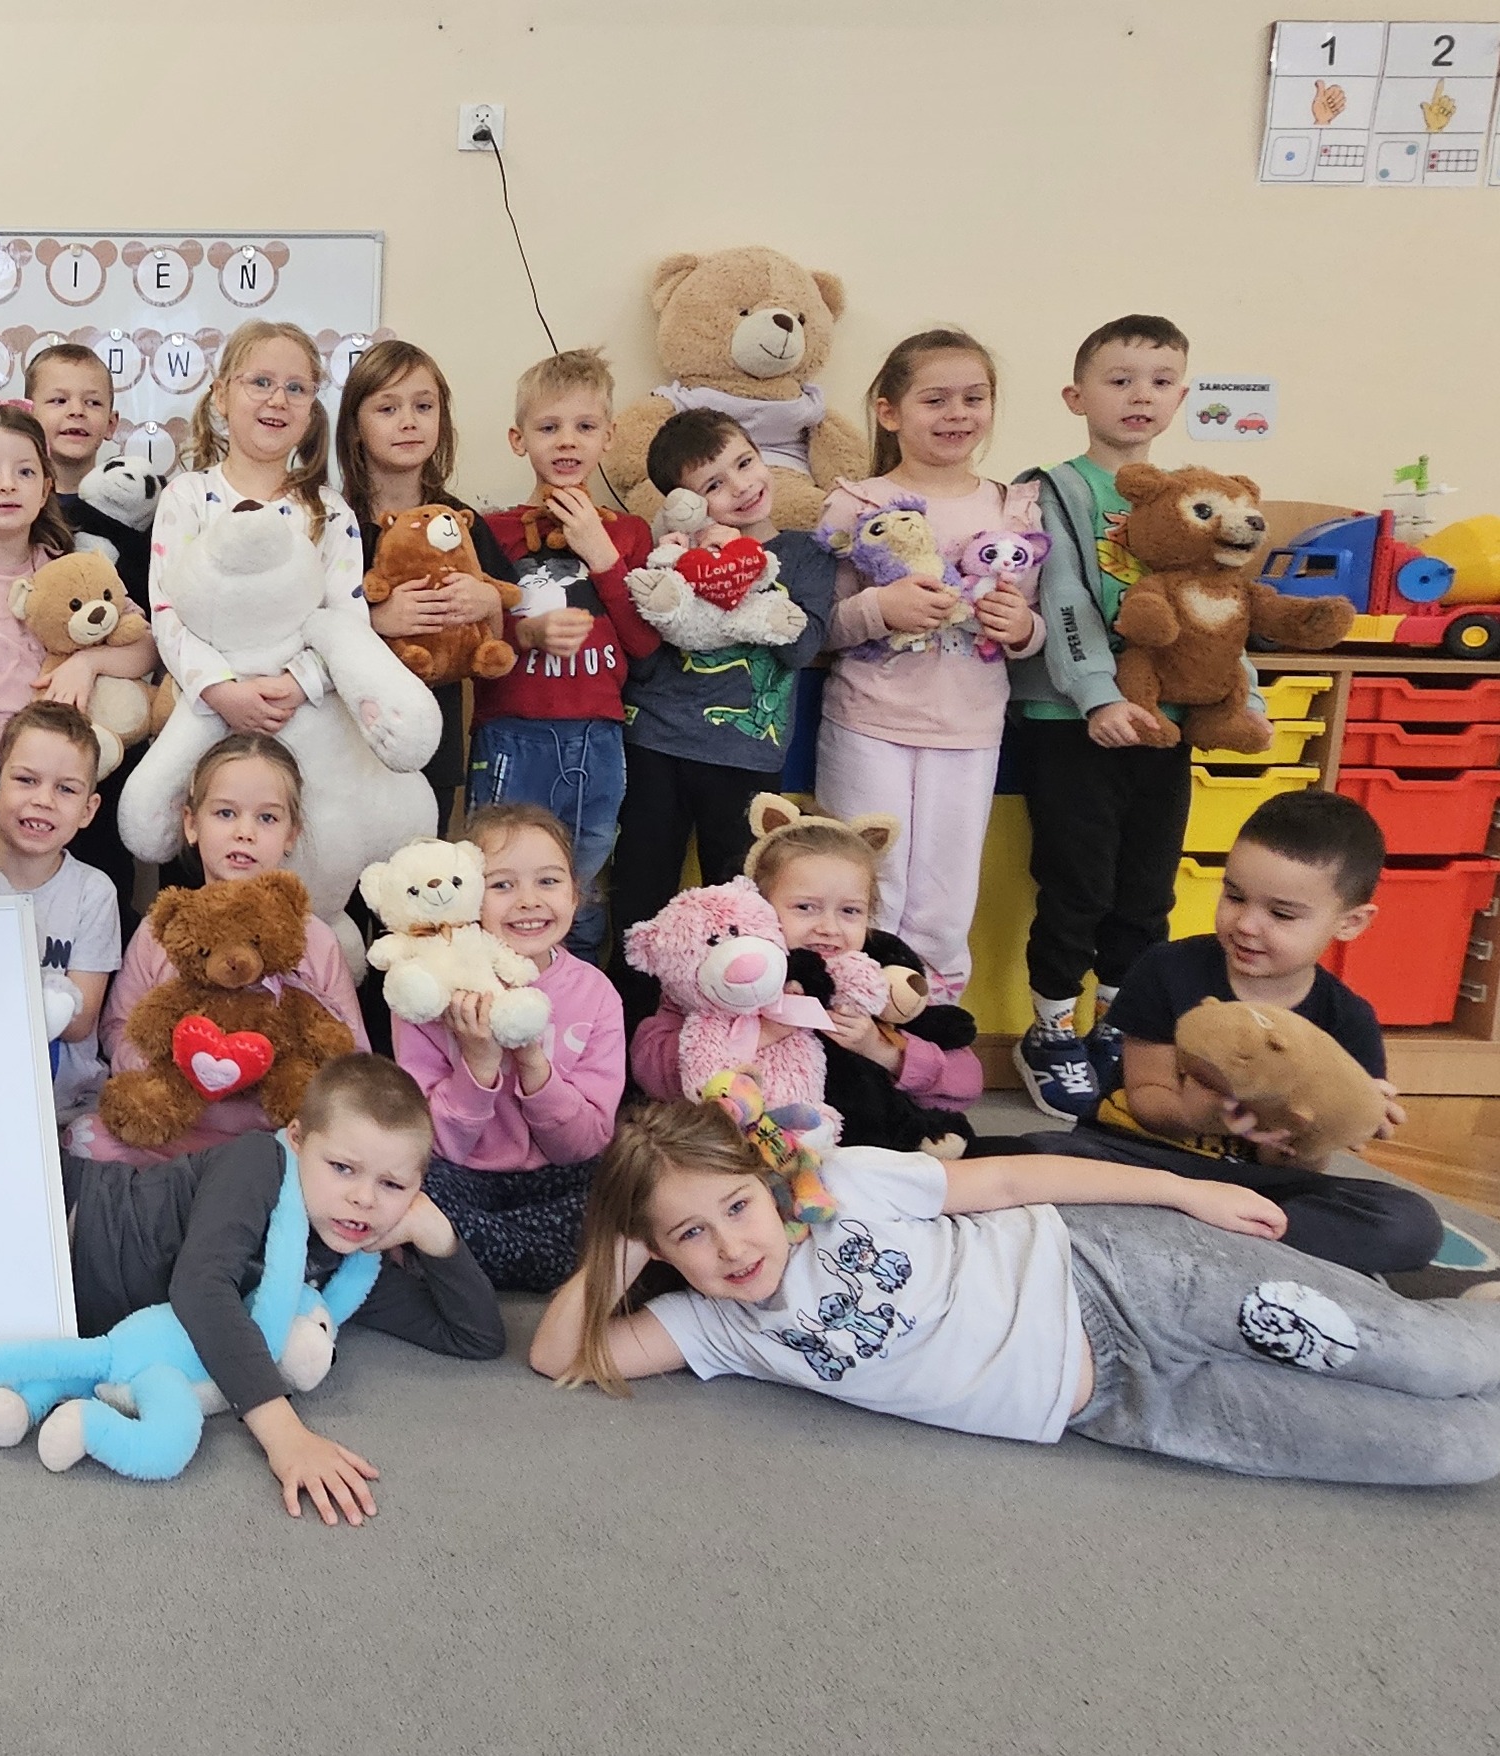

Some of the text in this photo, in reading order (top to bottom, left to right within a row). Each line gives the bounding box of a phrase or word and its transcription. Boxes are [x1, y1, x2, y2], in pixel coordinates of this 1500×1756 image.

[1320, 35, 1337, 66] 1
[1431, 34, 1456, 67] 2
[732, 569, 760, 584] Tha
[526, 644, 617, 677] ENIUS
